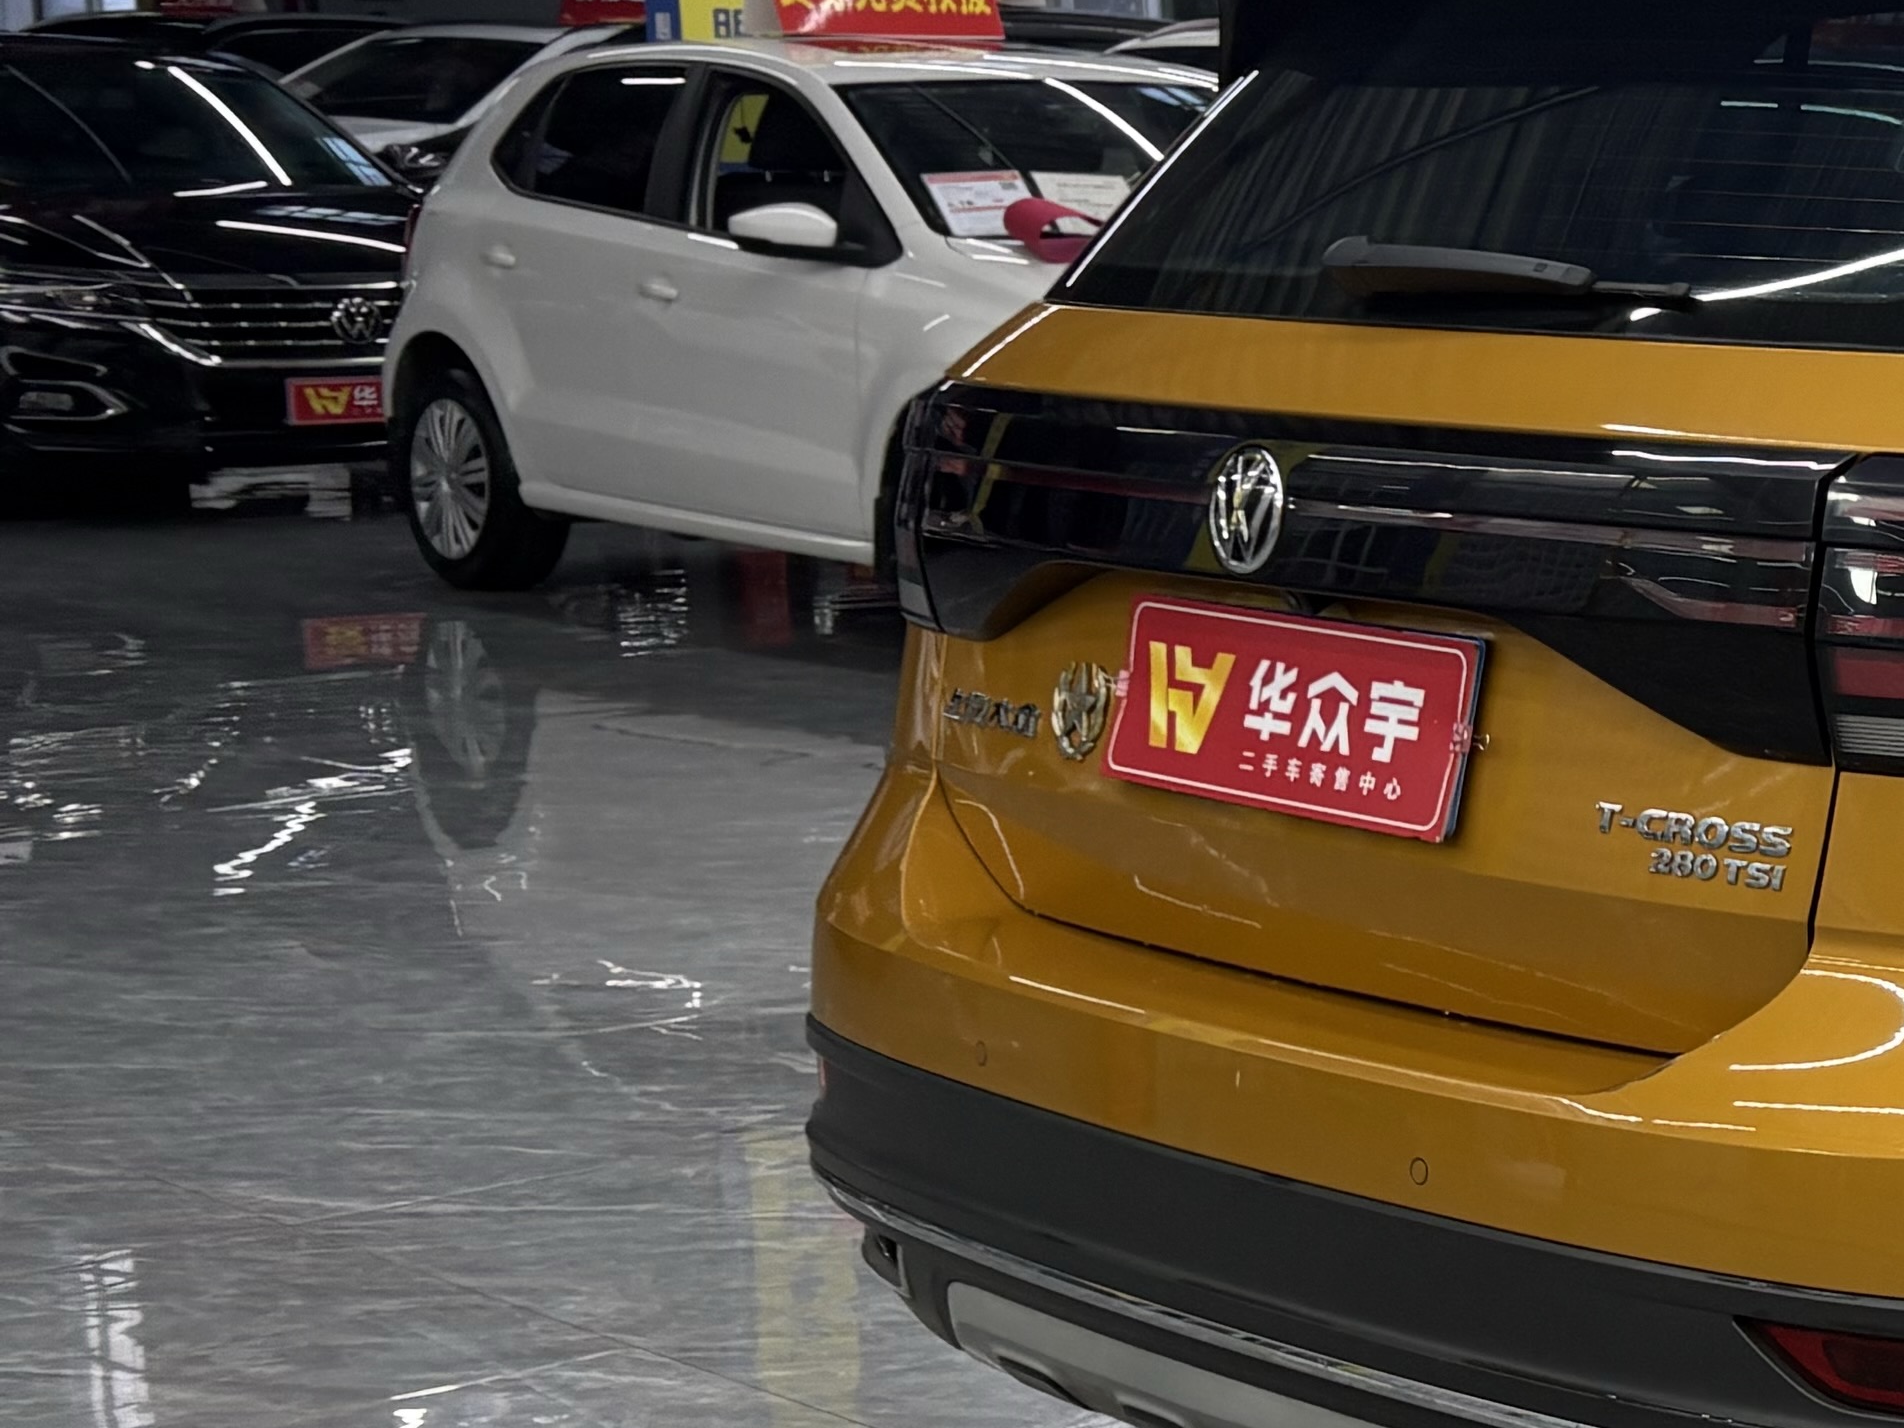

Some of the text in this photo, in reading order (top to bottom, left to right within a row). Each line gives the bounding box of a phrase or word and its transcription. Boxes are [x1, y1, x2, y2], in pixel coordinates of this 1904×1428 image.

[1243, 658, 1426, 763] 华众宇
[1238, 750, 1402, 801] 二手车寄售中心
[1595, 800, 1793, 858] T-CROSS
[1648, 847, 1787, 891] 280 TSI
